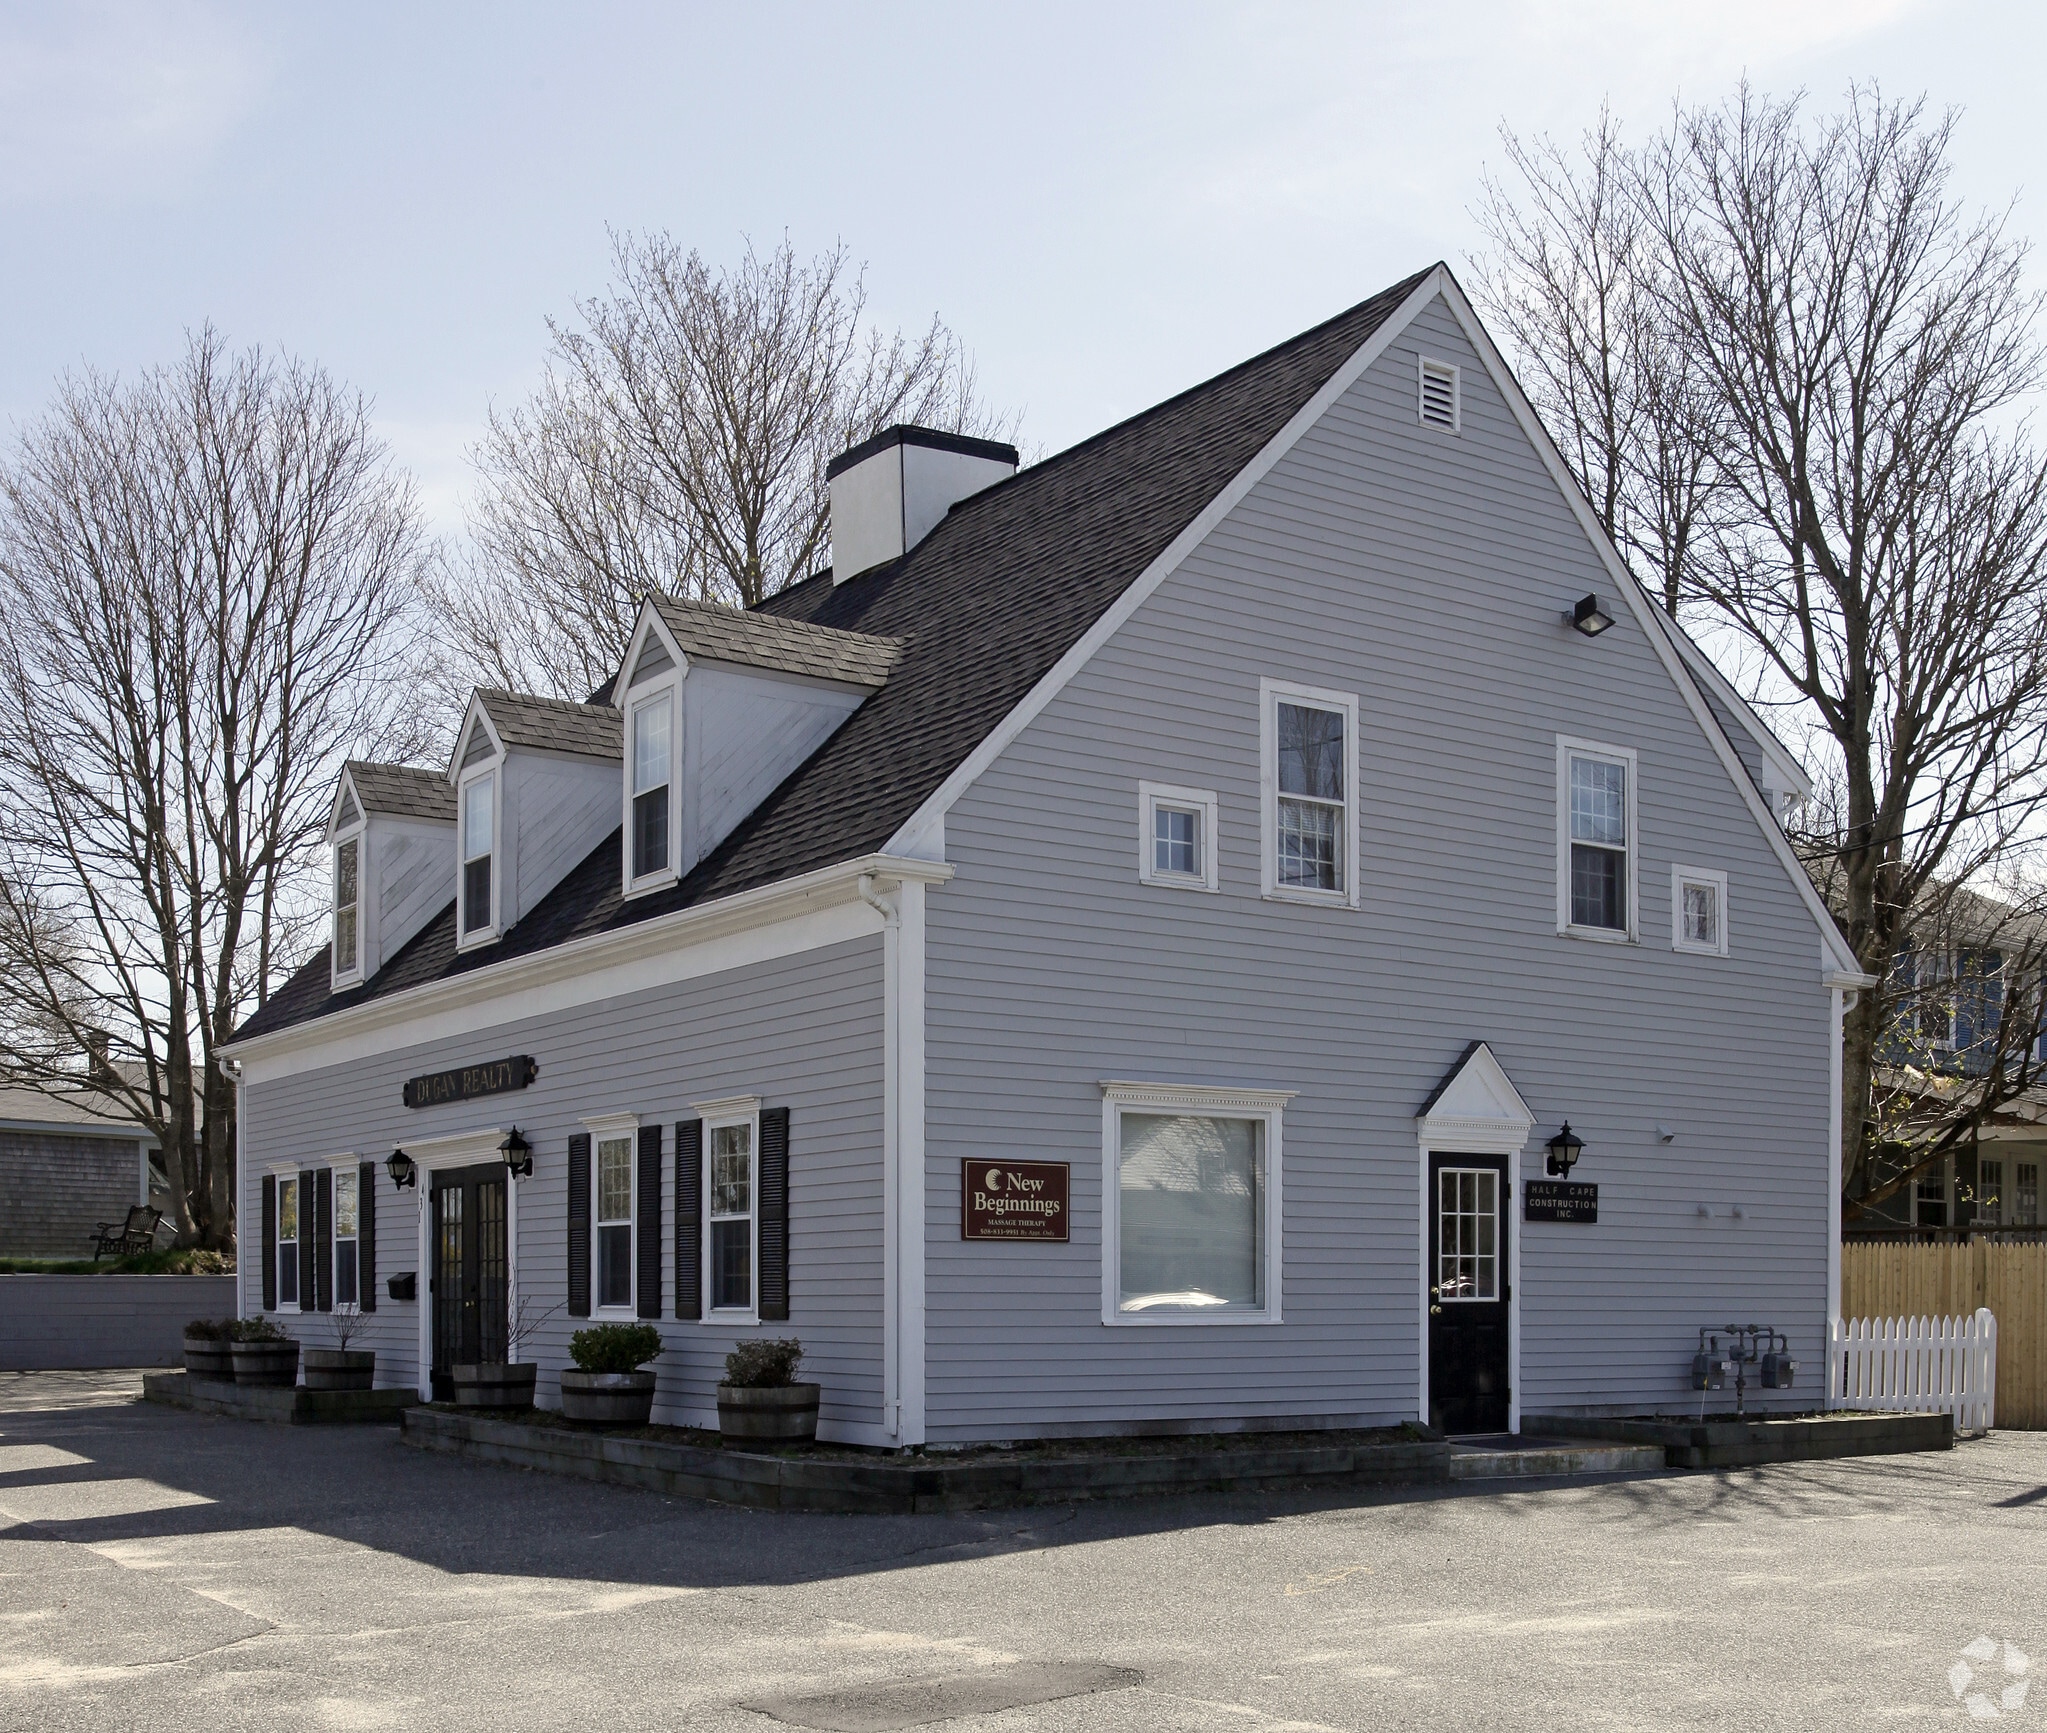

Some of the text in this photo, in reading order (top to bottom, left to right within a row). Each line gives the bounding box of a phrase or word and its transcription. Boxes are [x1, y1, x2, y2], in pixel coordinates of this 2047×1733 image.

[417, 1062, 512, 1103] DUGAN REALTY
[1006, 1172, 1044, 1191] New
[1531, 1185, 1594, 1196] HALF CAPE
[974, 1191, 1060, 1217] Beginnings
[1529, 1198, 1597, 1209] CONSTRUCTION
[1556, 1209, 1574, 1218] INC.
